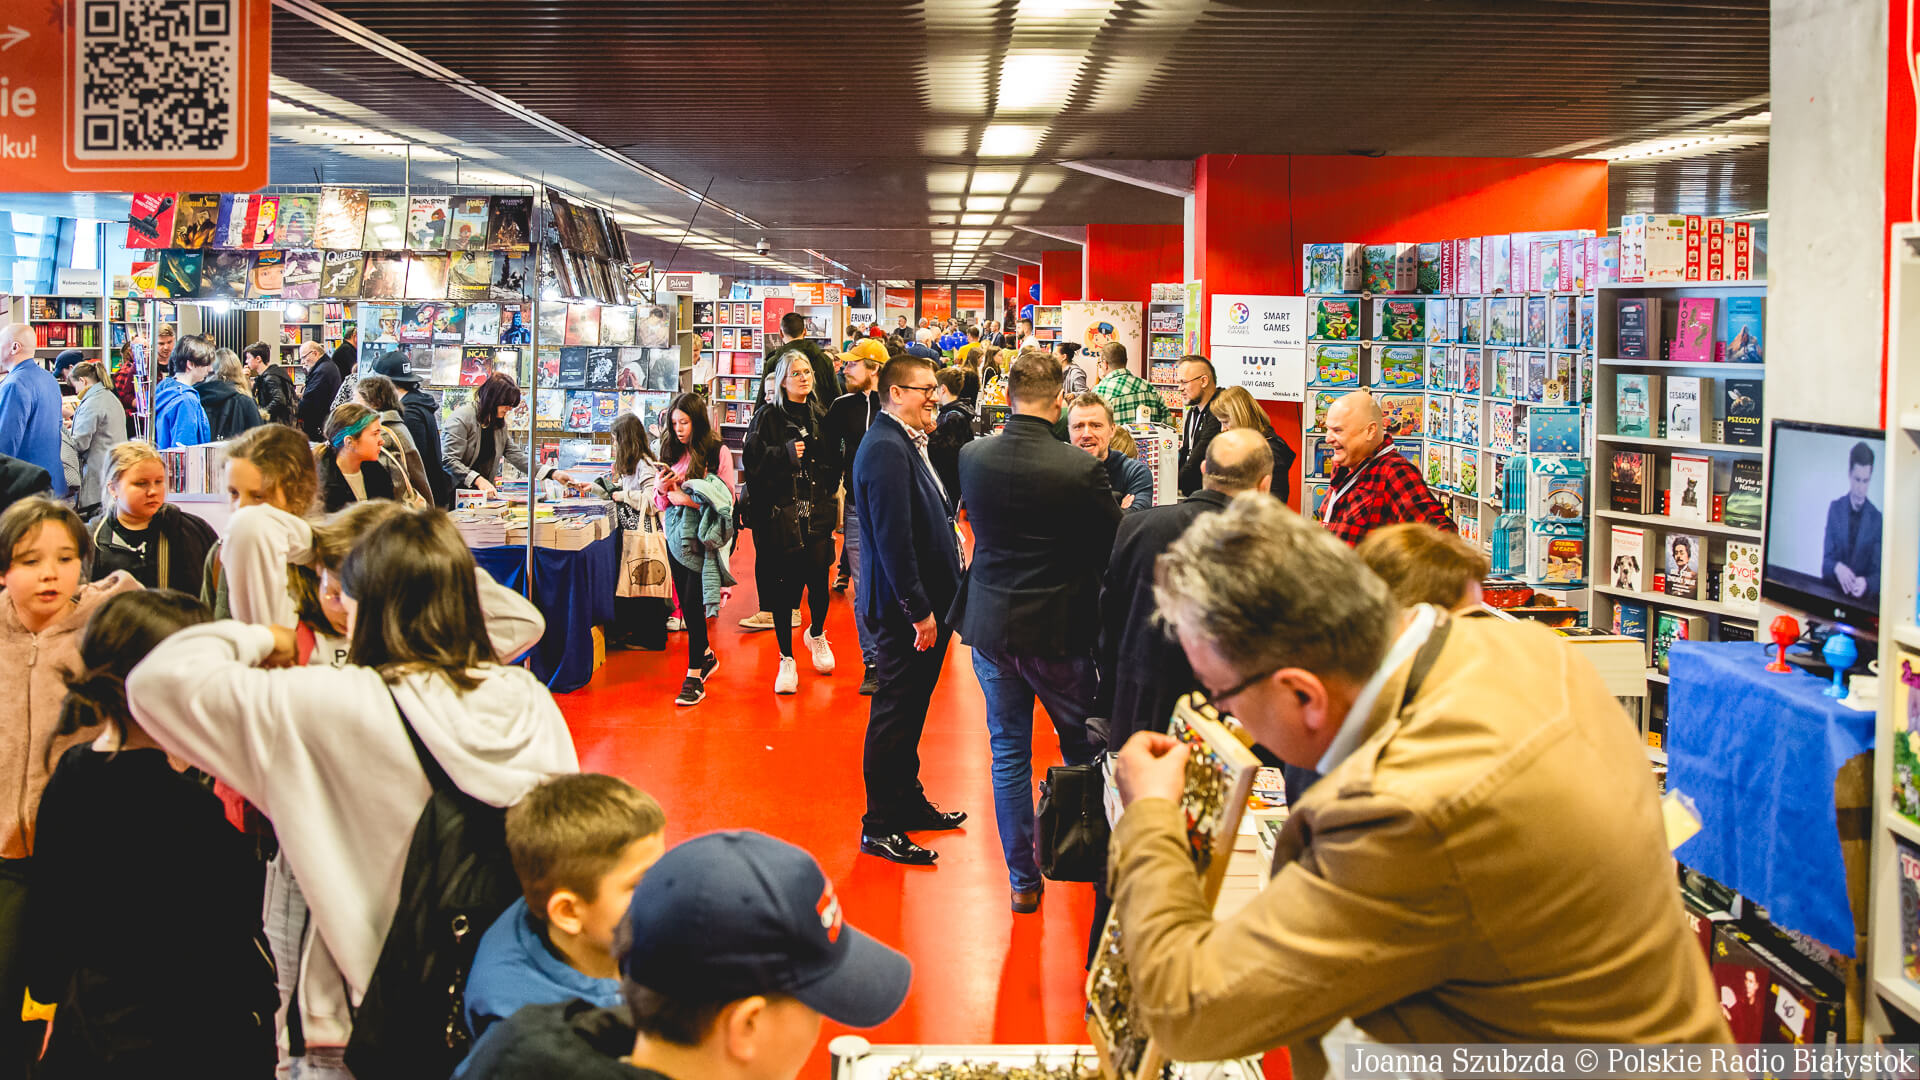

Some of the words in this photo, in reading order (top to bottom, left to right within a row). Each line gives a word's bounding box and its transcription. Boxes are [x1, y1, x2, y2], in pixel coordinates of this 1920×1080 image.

[0, 76, 37, 118] ie
[1263, 312, 1290, 320] SMART
[1263, 323, 1290, 332] GAMES
[466, 350, 489, 358] INCAL
[1242, 355, 1276, 366] IUVI
[1255, 380, 1275, 388] GAMES
[1735, 476, 1756, 486] Ukryte
